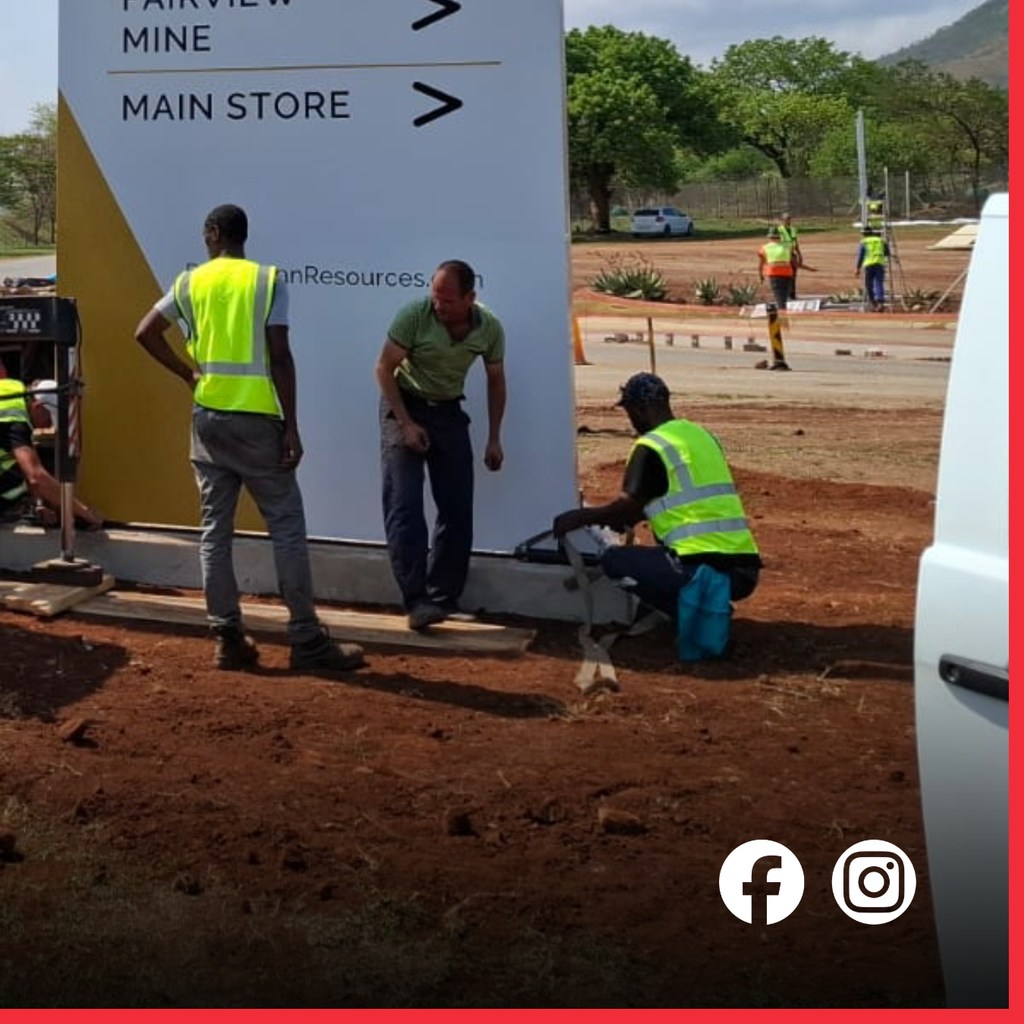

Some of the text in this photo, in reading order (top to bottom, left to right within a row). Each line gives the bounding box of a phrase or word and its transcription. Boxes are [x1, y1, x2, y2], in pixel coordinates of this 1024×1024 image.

[123, 24, 212, 54] MINE
[122, 90, 351, 121] MAIN STORE
